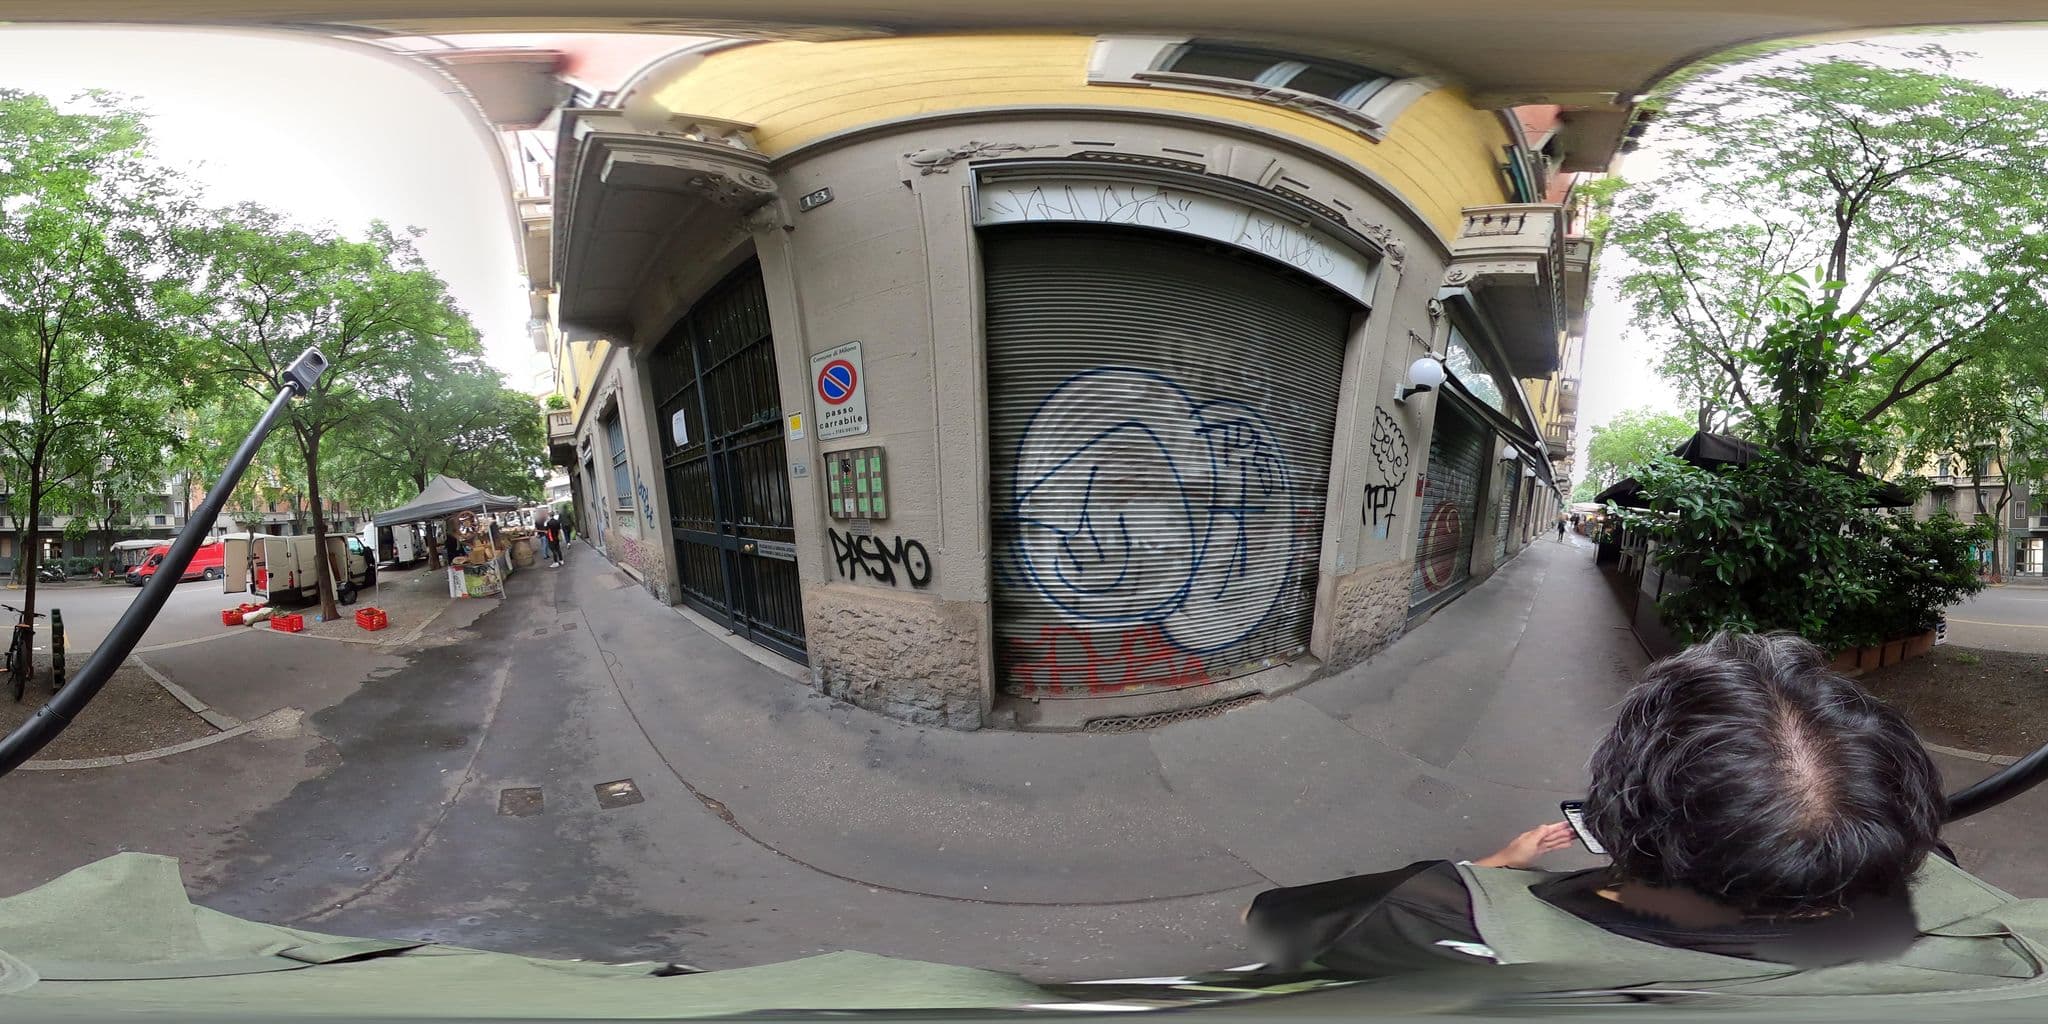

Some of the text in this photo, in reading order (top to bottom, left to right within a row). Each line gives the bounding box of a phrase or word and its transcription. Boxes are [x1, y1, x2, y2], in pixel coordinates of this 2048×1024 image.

[806, 191, 827, 207] 13
[825, 406, 854, 419] passo
[819, 415, 863, 430] carrabile
[828, 527, 933, 589] PASMO
